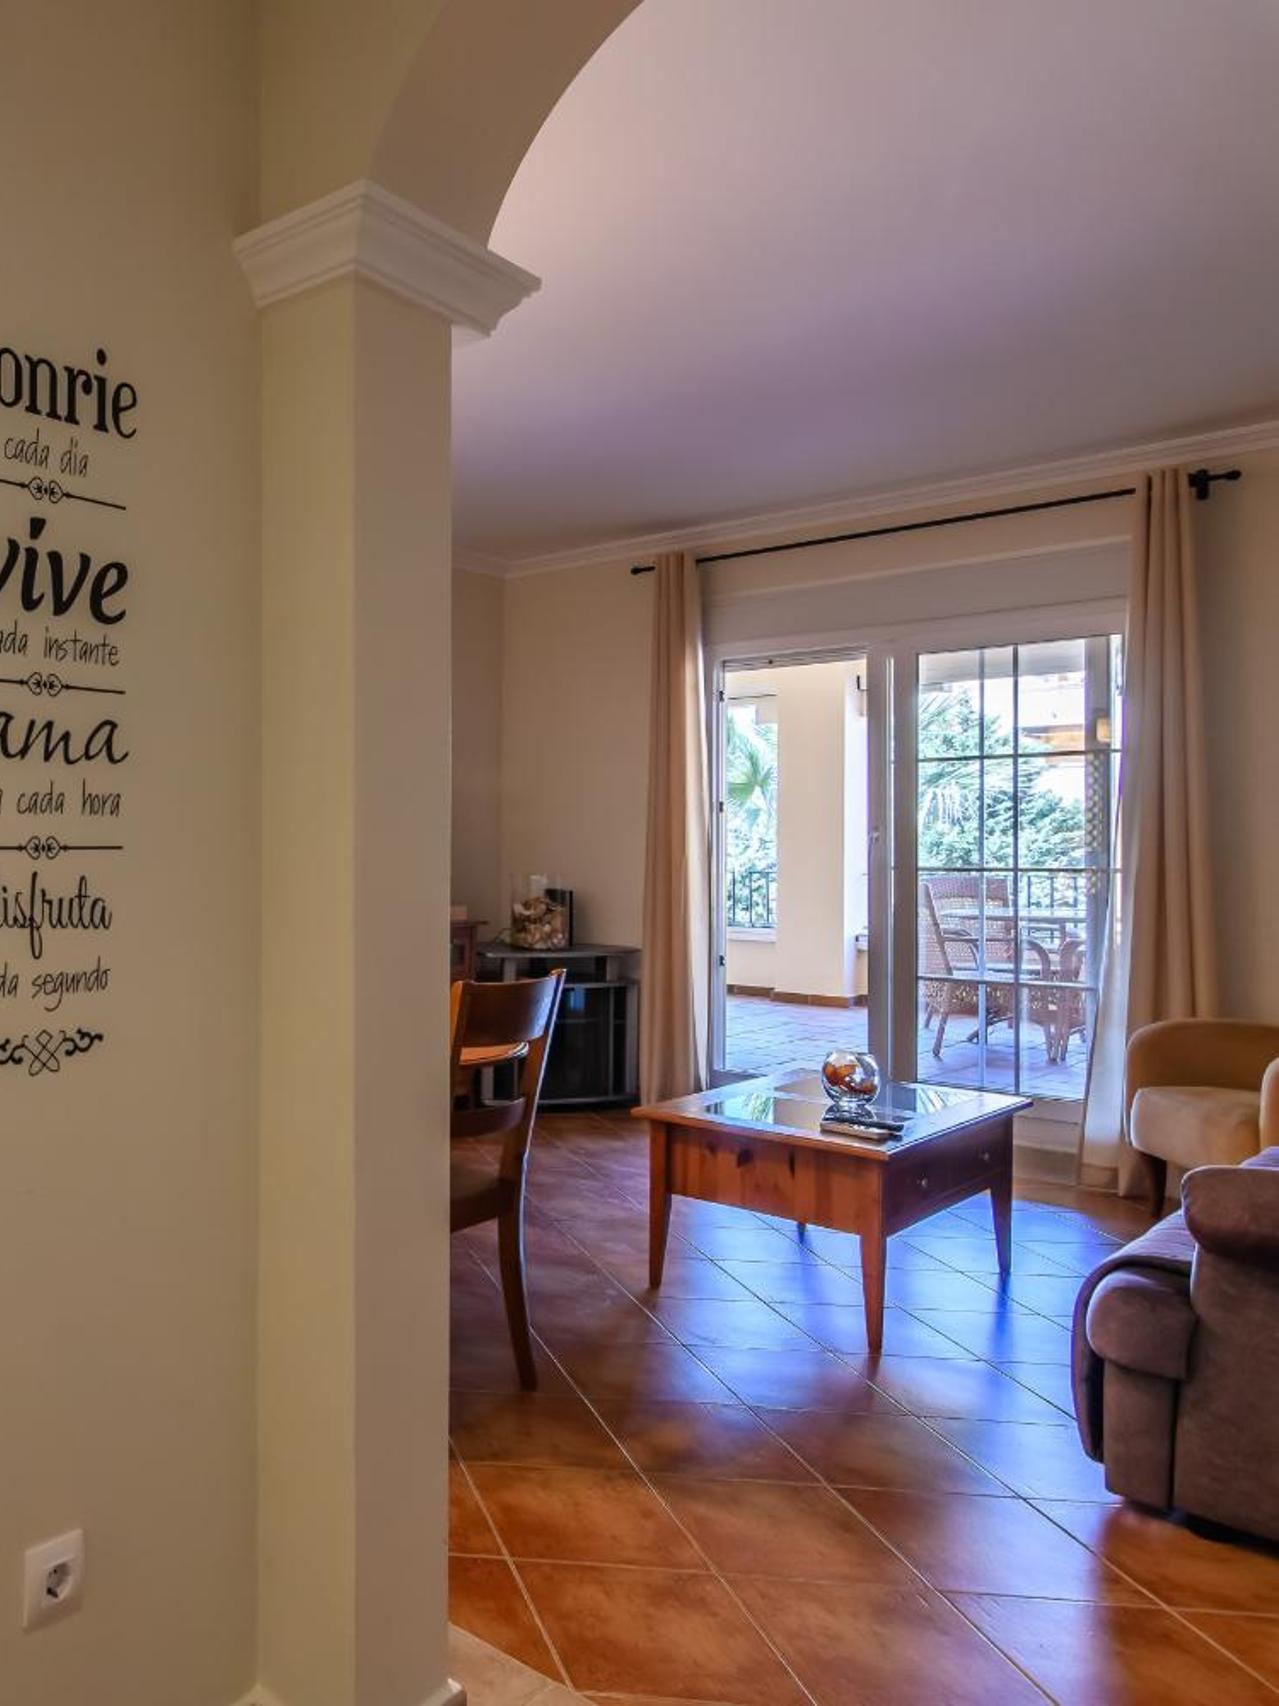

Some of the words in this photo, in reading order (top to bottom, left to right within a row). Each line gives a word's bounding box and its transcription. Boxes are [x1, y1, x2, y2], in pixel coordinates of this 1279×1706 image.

[3, 427, 50, 470] cada
[43, 625, 121, 668] instante
[16, 780, 65, 816] cada
[81, 778, 121, 818] hora
[31, 956, 111, 1012] segundo
